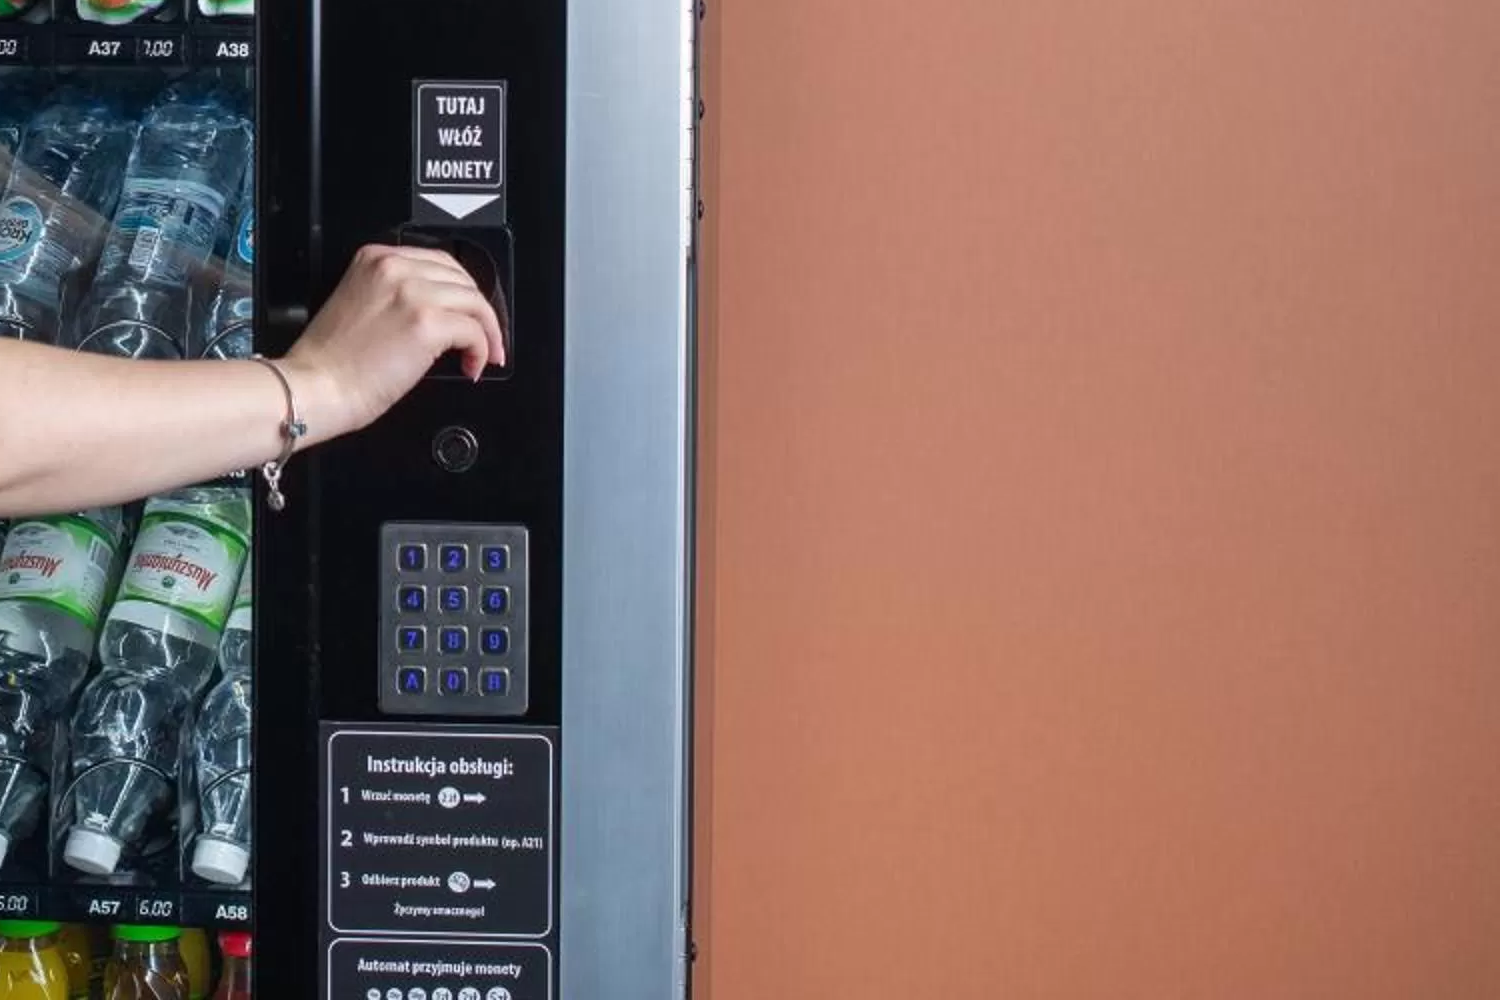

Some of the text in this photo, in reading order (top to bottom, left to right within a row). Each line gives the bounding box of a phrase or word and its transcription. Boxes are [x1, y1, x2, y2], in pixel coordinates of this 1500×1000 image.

[87, 41, 121, 56] A37
[215, 42, 249, 57] A38
[435, 96, 485, 115] TUTAJ
[438, 125, 483, 147] WŁÓŻ
[425, 160, 494, 179] MONETY
[408, 551, 415, 565] 1
[450, 551, 459, 567] 2
[490, 552, 500, 567] 3
[407, 592, 418, 607] 4
[449, 592, 459, 607] 5
[490, 593, 500, 608] 6
[408, 632, 417, 646] 7
[490, 634, 500, 648] 9
[407, 674, 418, 688] A
[367, 755, 514, 779] Instrukcja obsługi:
[340, 787, 349, 804] 1
[340, 829, 353, 847] 2
[415, 833, 451, 847] symbol
[452, 833, 499, 849] produktu
[340, 871, 350, 888] 3
[401, 875, 441, 889] produkt
[89, 900, 121, 915] A57
[215, 905, 248, 920] A58
[357, 957, 522, 979] Automat przyjmuje monety
